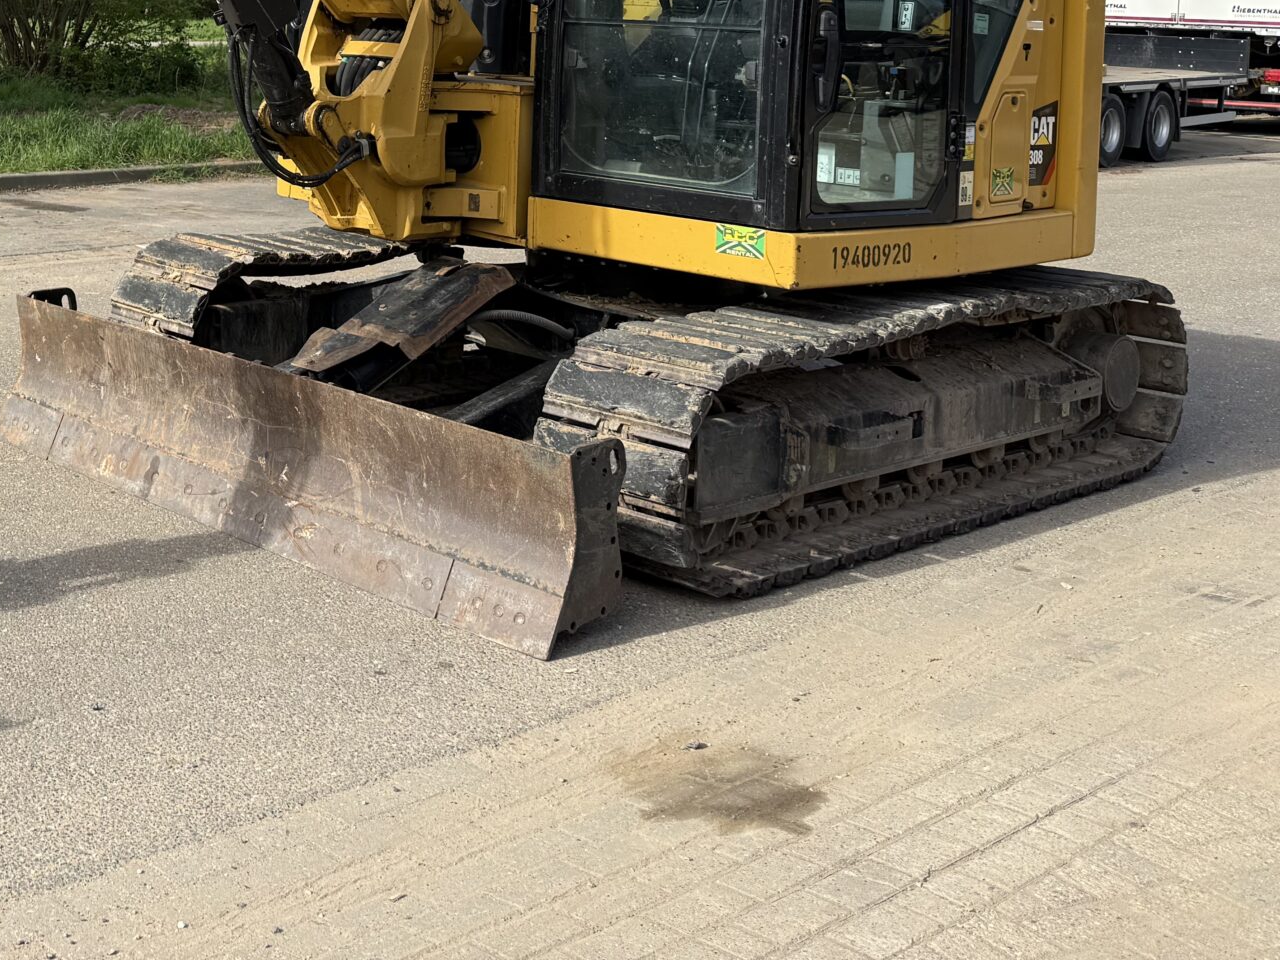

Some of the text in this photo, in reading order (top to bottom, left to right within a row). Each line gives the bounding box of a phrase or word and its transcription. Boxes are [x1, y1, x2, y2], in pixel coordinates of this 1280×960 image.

[1030, 116, 1056, 145] CAT
[1028, 149, 1044, 165] 308
[726, 249, 755, 258] RENTAL
[832, 242, 912, 269] 19400920
